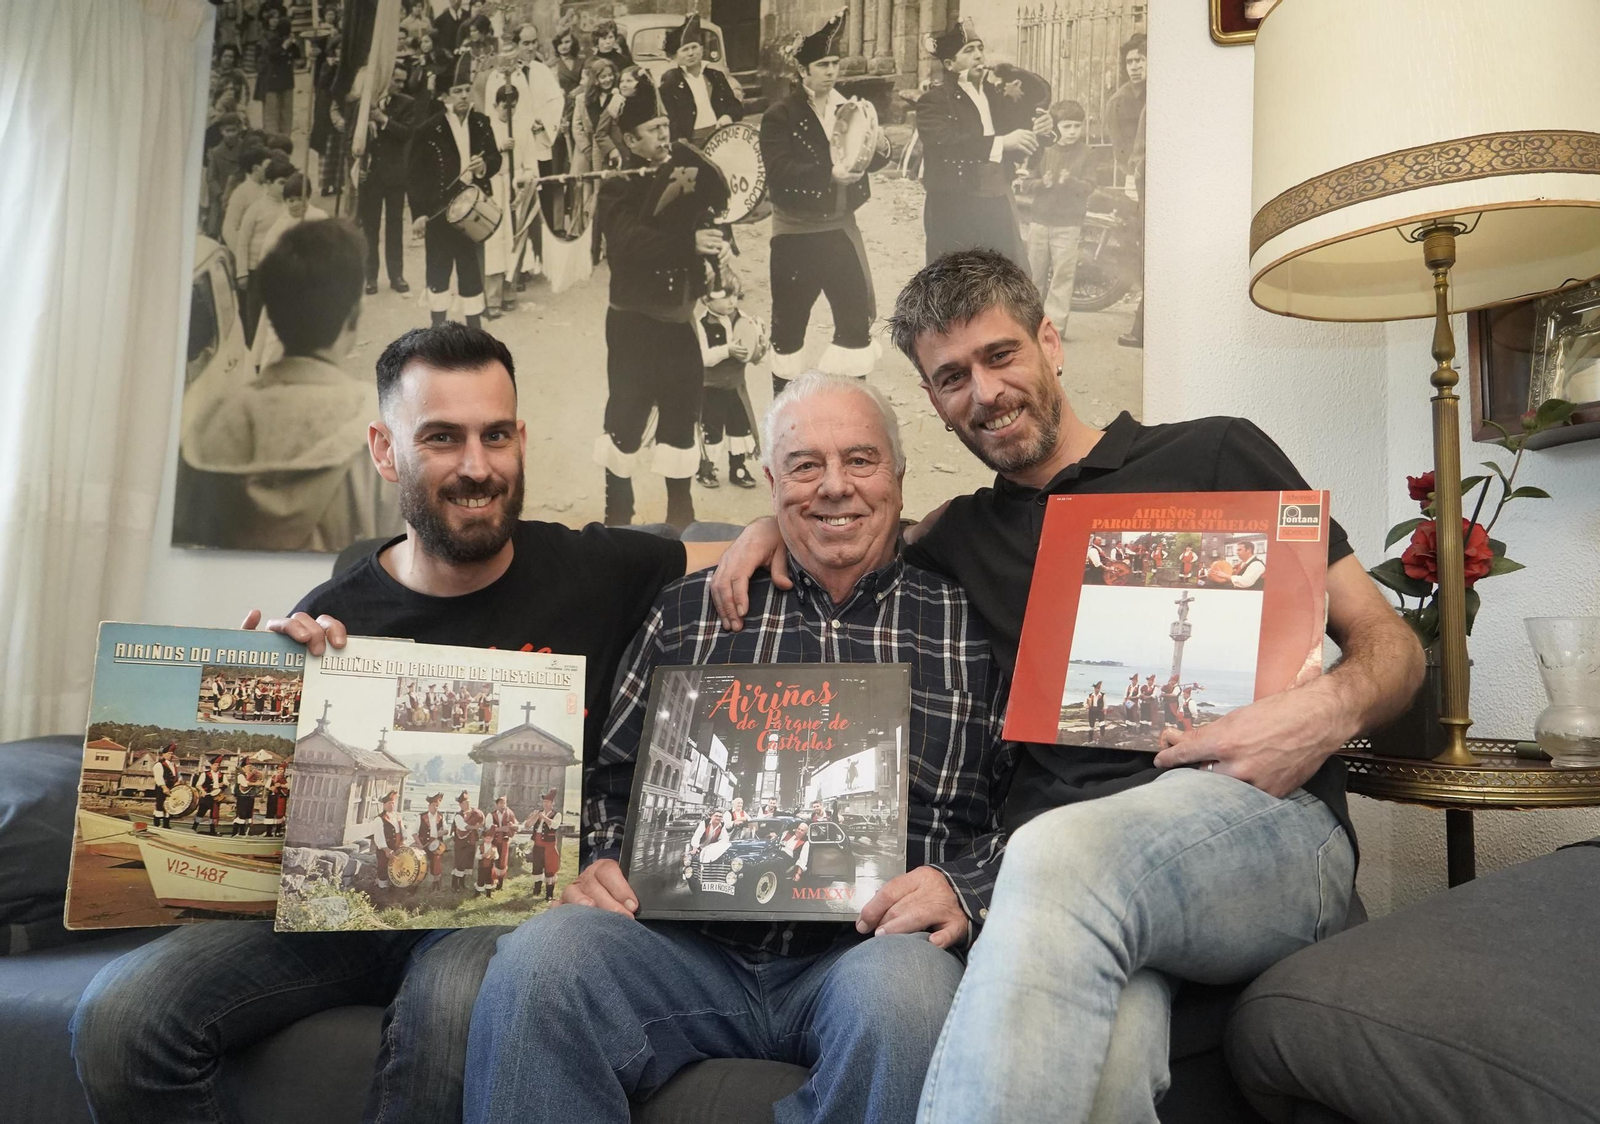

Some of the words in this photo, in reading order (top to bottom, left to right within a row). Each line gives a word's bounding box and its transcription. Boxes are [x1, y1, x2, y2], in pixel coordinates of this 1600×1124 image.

[704, 127, 740, 157] PARQUE
[742, 129, 754, 144] DE
[1091, 518, 1152, 529] PARQUE
[1154, 519, 1175, 530] DE
[1177, 519, 1270, 531] CASTRELOS
[1132, 505, 1197, 519] AIRIÑOS
[1201, 508, 1224, 519] DO
[1282, 505, 1319, 525] fontana
[114, 642, 185, 662] AIRIÑOS
[190, 647, 211, 663] DO
[215, 648, 280, 666] PARQUE
[284, 652, 304, 667] DE
[320, 655, 383, 674] AIRIÑOS
[386, 660, 405, 675] DO
[409, 662, 466, 680] PARQUE
[469, 666, 488, 681] DE
[491, 667, 572, 687] CASTRELOS
[708, 679, 838, 723] Airiños
[735, 712, 759, 730] do
[765, 708, 823, 734] Parque
[828, 712, 850, 730] de
[756, 730, 836, 753] Castrelos
